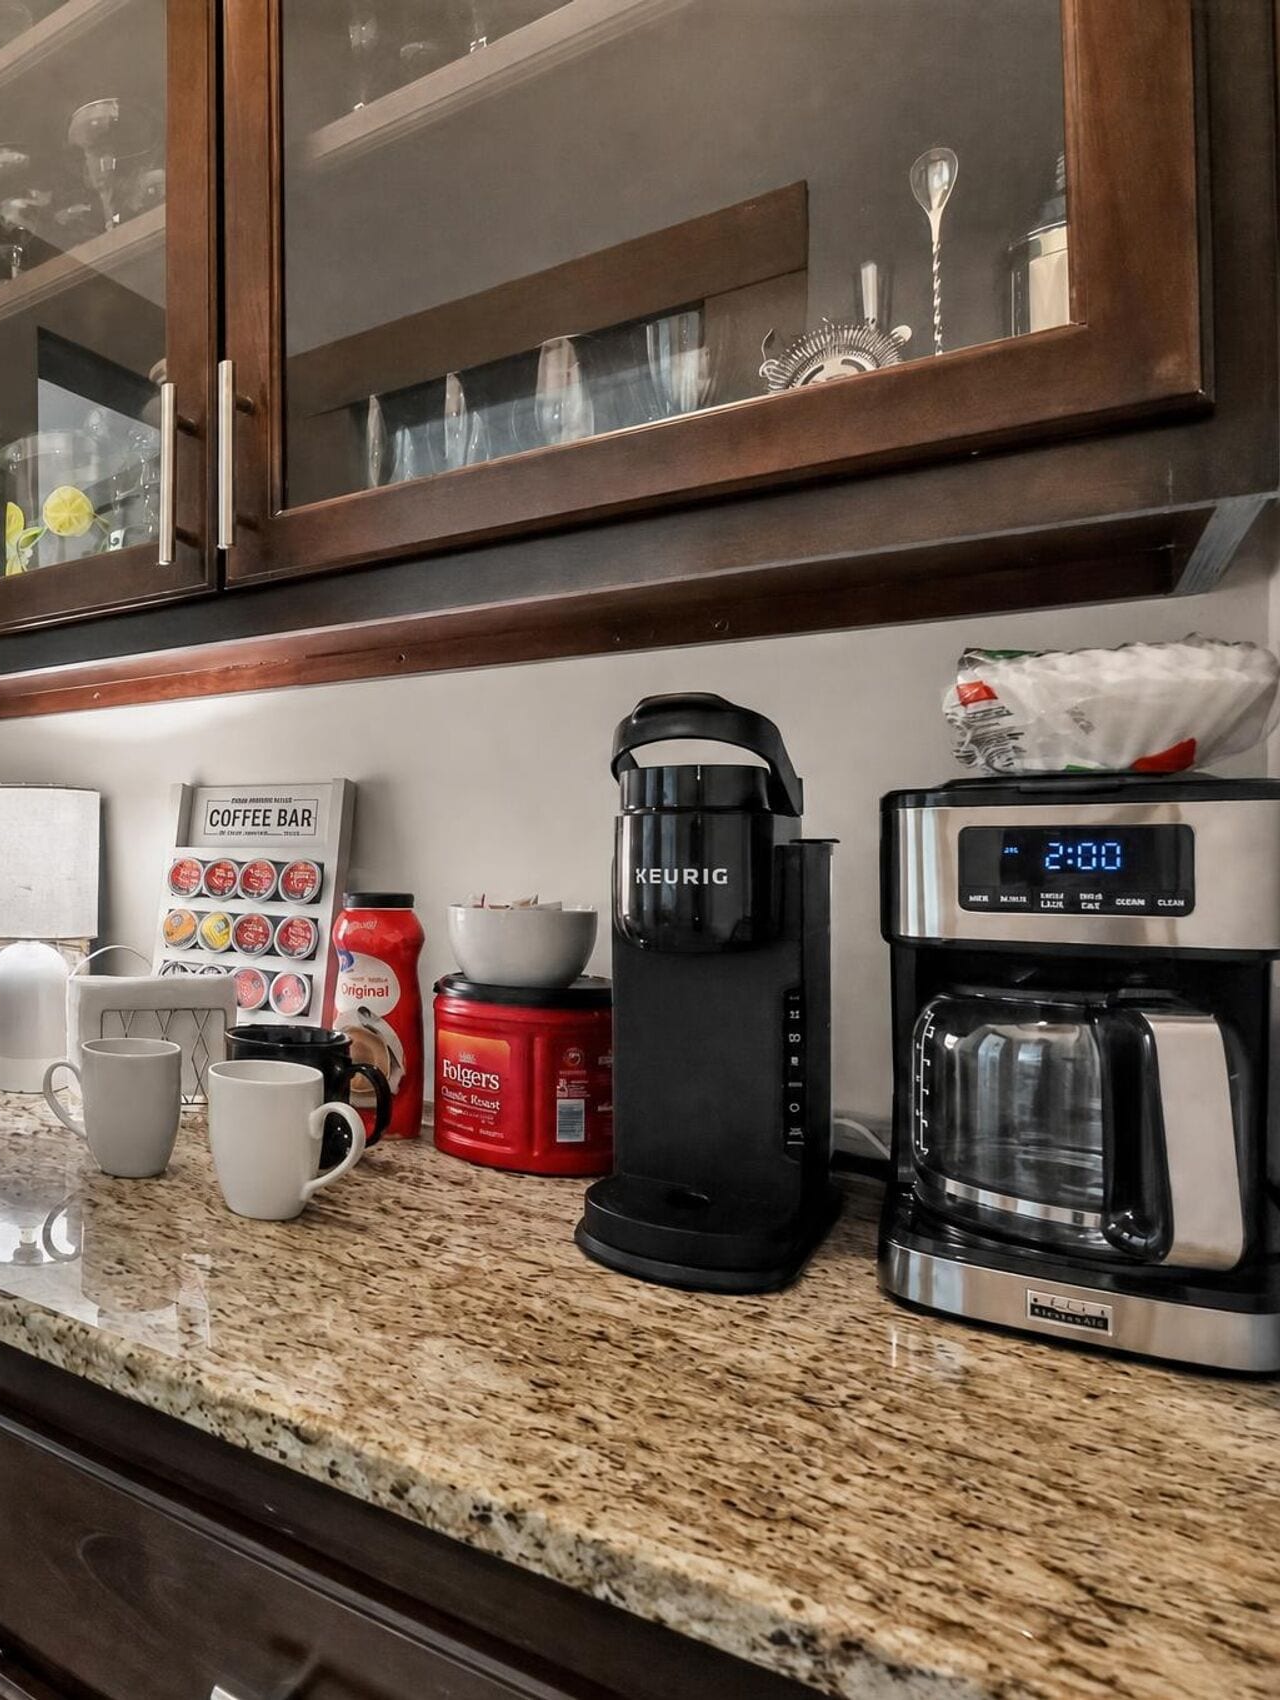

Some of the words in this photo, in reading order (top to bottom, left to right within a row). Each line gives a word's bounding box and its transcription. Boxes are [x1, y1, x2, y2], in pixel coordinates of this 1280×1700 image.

[209, 808, 272, 827] COFFEE
[277, 808, 312, 827] BAR
[1044, 842, 1121, 870] 2:00
[635, 868, 728, 885] KEURIG
[1157, 899, 1185, 907] CLEAN
[342, 982, 389, 1000] Original
[443, 1059, 500, 1090] Folgers
